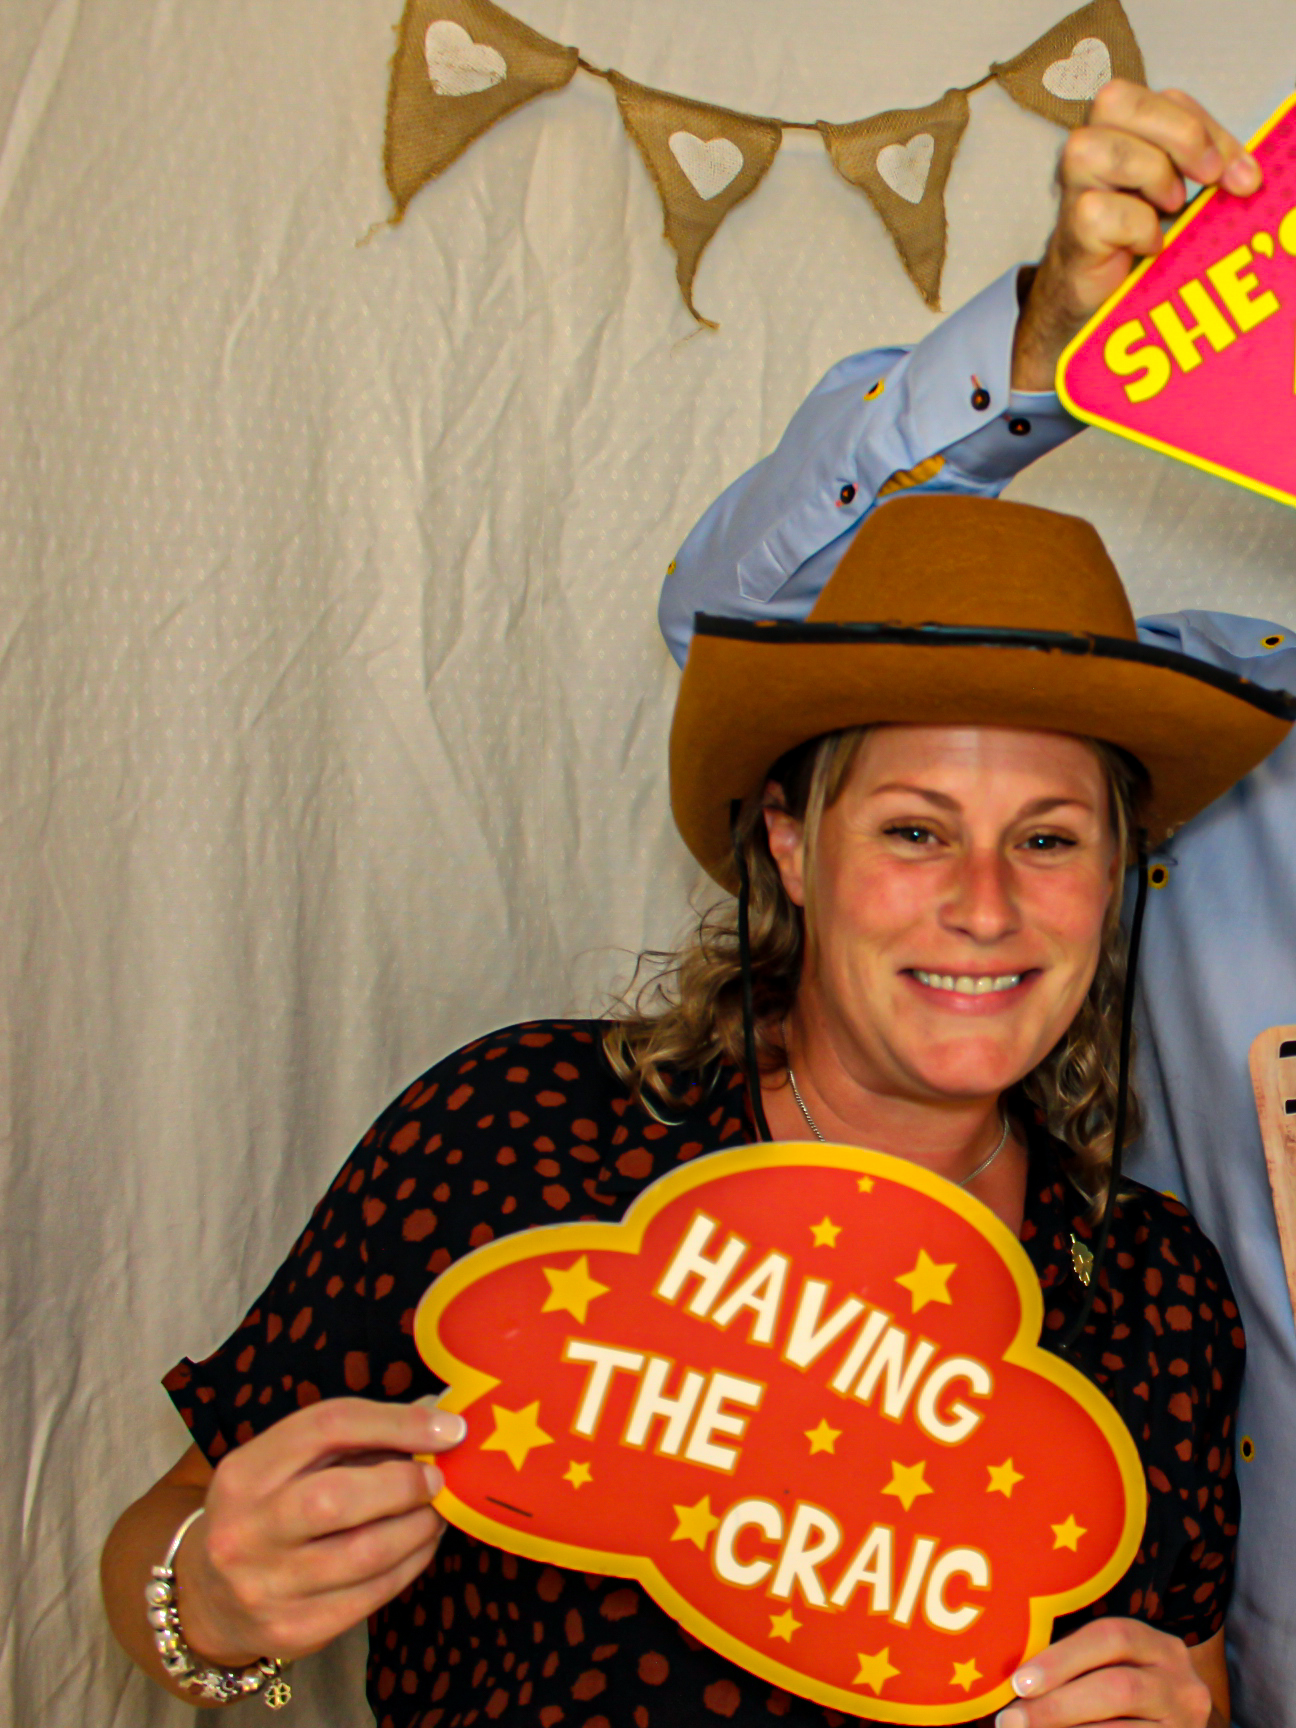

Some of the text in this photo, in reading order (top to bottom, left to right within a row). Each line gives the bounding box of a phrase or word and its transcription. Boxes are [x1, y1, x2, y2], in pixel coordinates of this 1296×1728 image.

[654, 1211, 993, 1445] HAVING
[563, 1338, 766, 1473] THE
[713, 1497, 992, 1633] CRAIC
